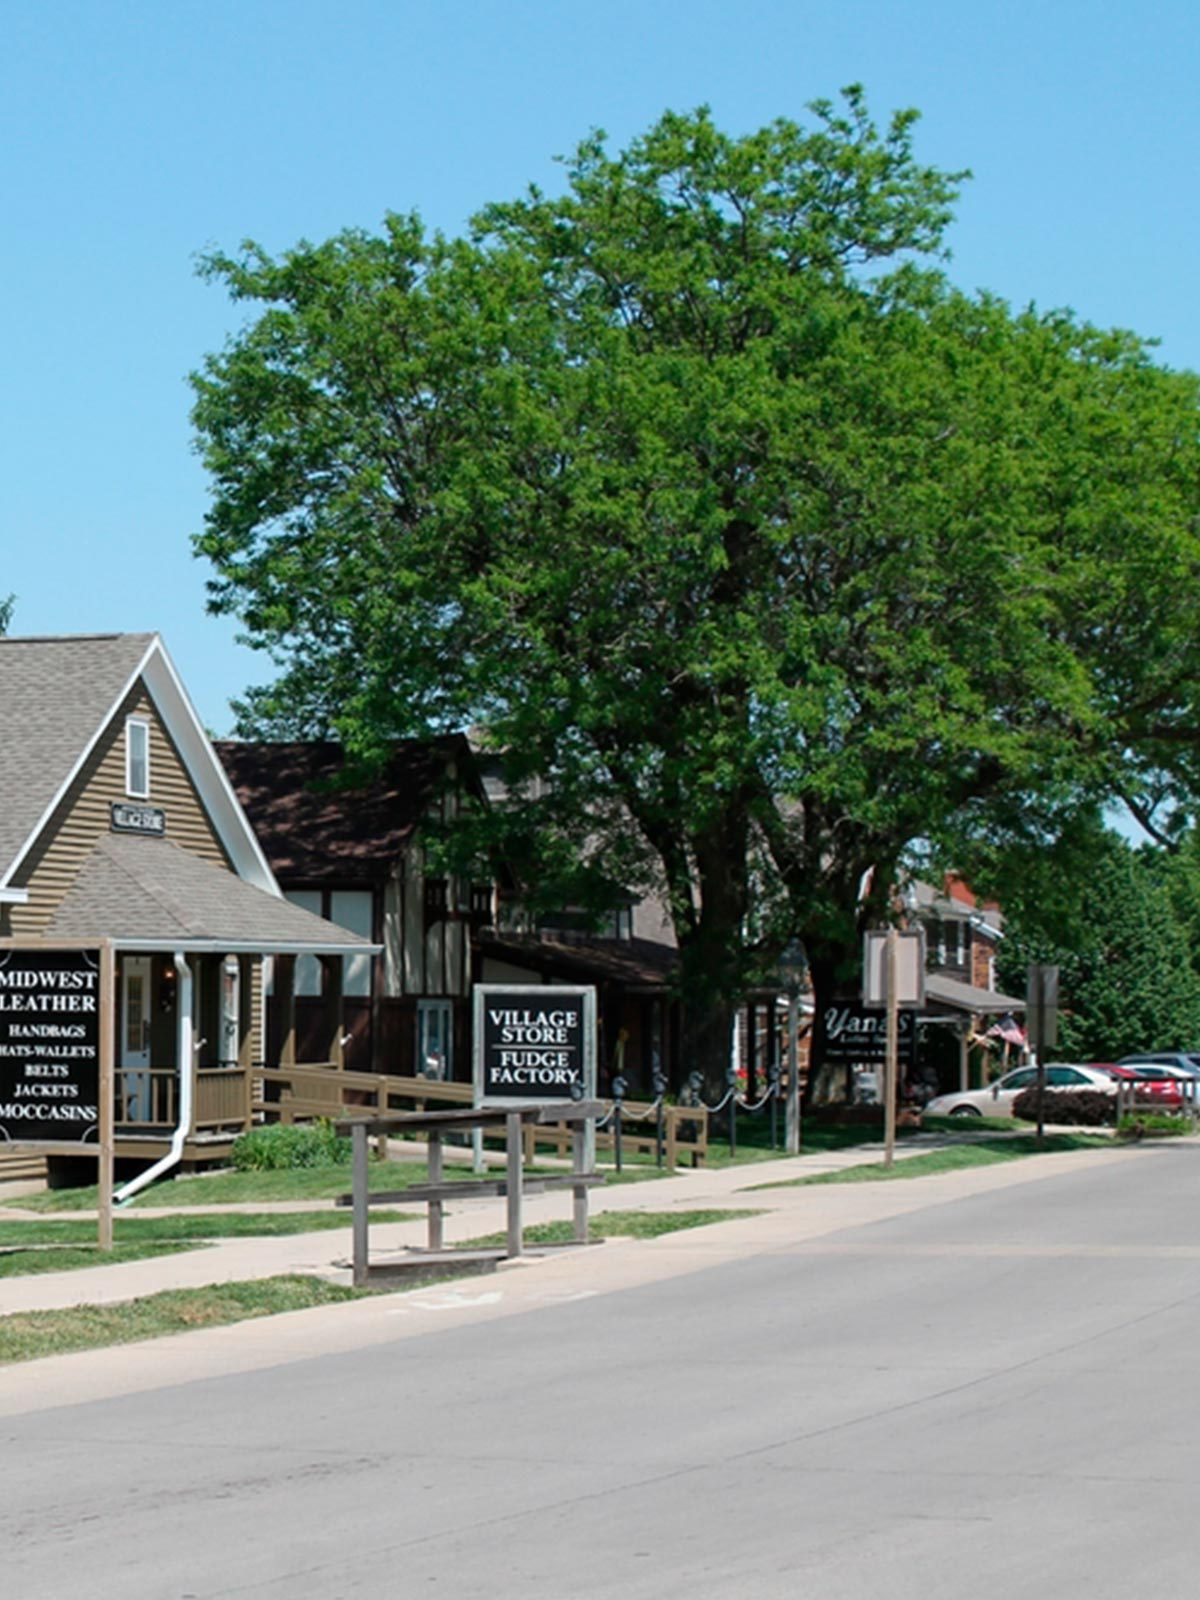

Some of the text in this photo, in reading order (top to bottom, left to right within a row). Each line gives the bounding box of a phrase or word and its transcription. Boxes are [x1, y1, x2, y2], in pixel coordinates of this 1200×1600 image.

[489, 1009, 577, 1028] VILLAGE
[8, 1023, 86, 1038] HANDBAGS
[501, 1027, 568, 1043] STORE
[501, 1051, 569, 1068] FUDGE
[24, 1064, 69, 1077] BELTS
[490, 1068, 579, 1084] FACTORY
[13, 1084, 79, 1097] JACKETS
